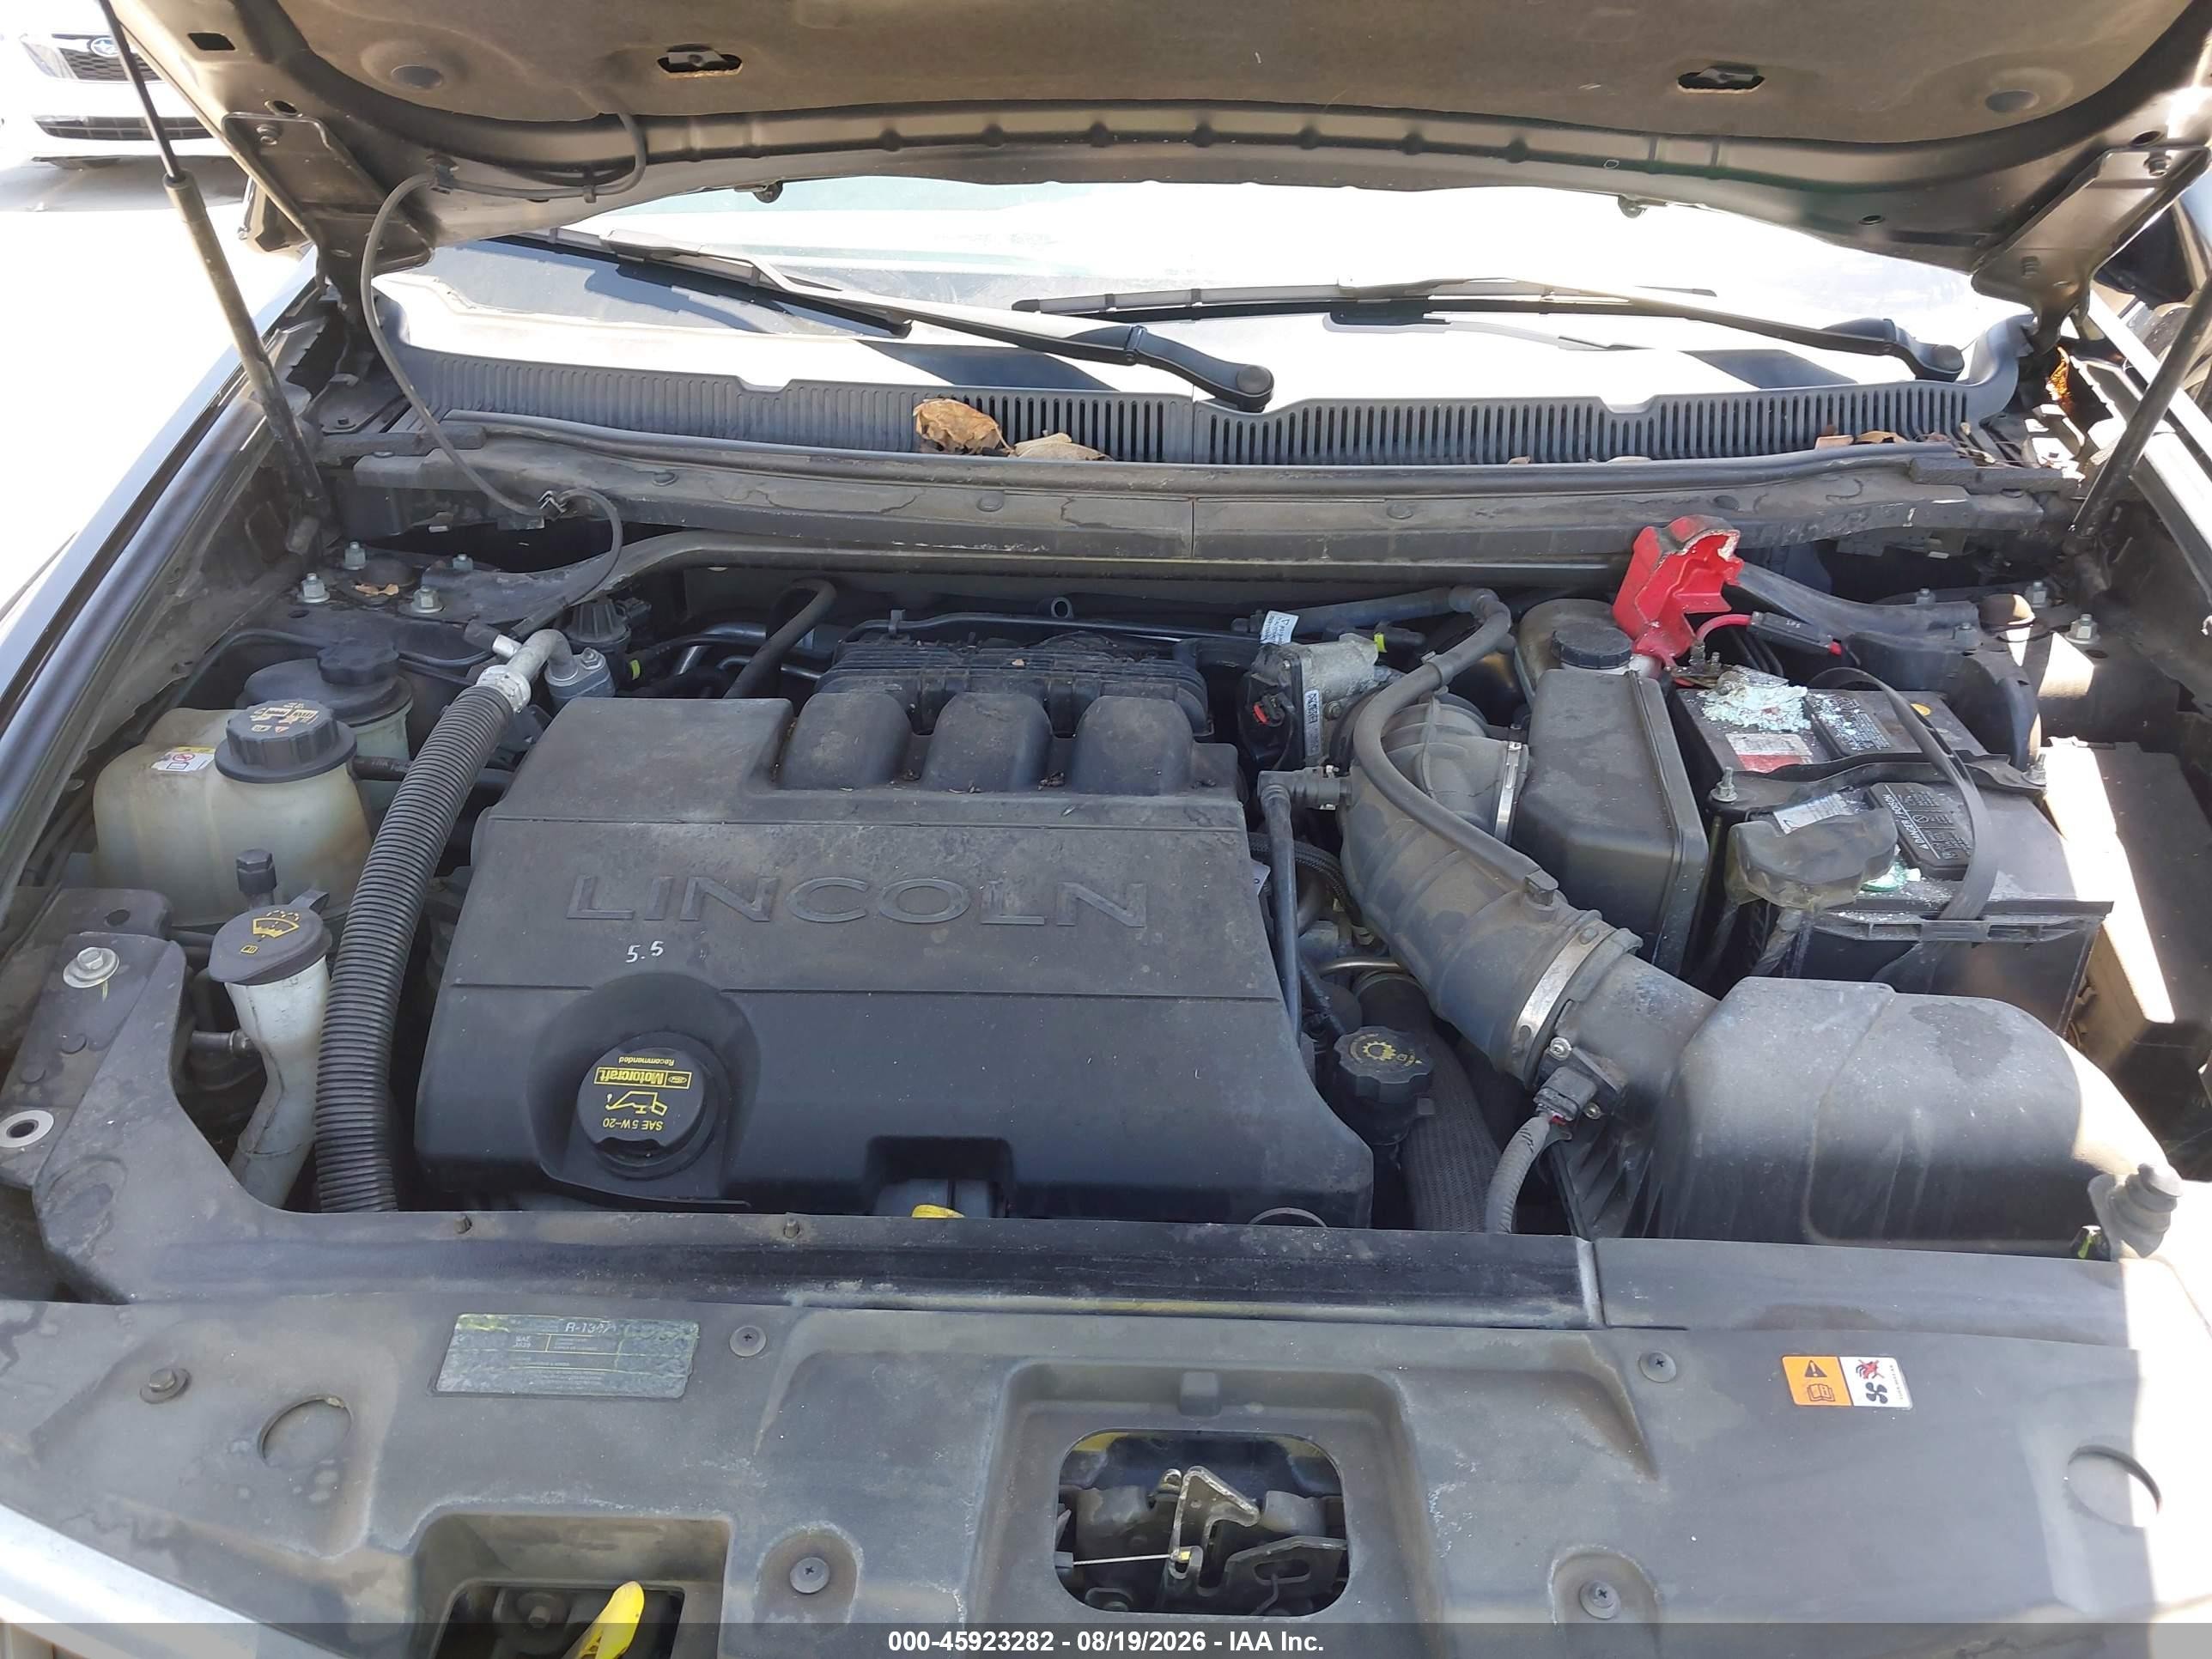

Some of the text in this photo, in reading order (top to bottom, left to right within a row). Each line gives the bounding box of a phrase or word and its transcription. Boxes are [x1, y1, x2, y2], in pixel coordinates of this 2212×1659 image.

[1882, 793, 1904, 816] POISON
[1901, 819, 1925, 843] DANGER
[566, 875, 1146, 928] LINCOLN
[618, 1056, 675, 1066] Recommended
[599, 1069, 665, 1085] Motorcraft
[603, 1117, 664, 1131] SAE 5W-20
